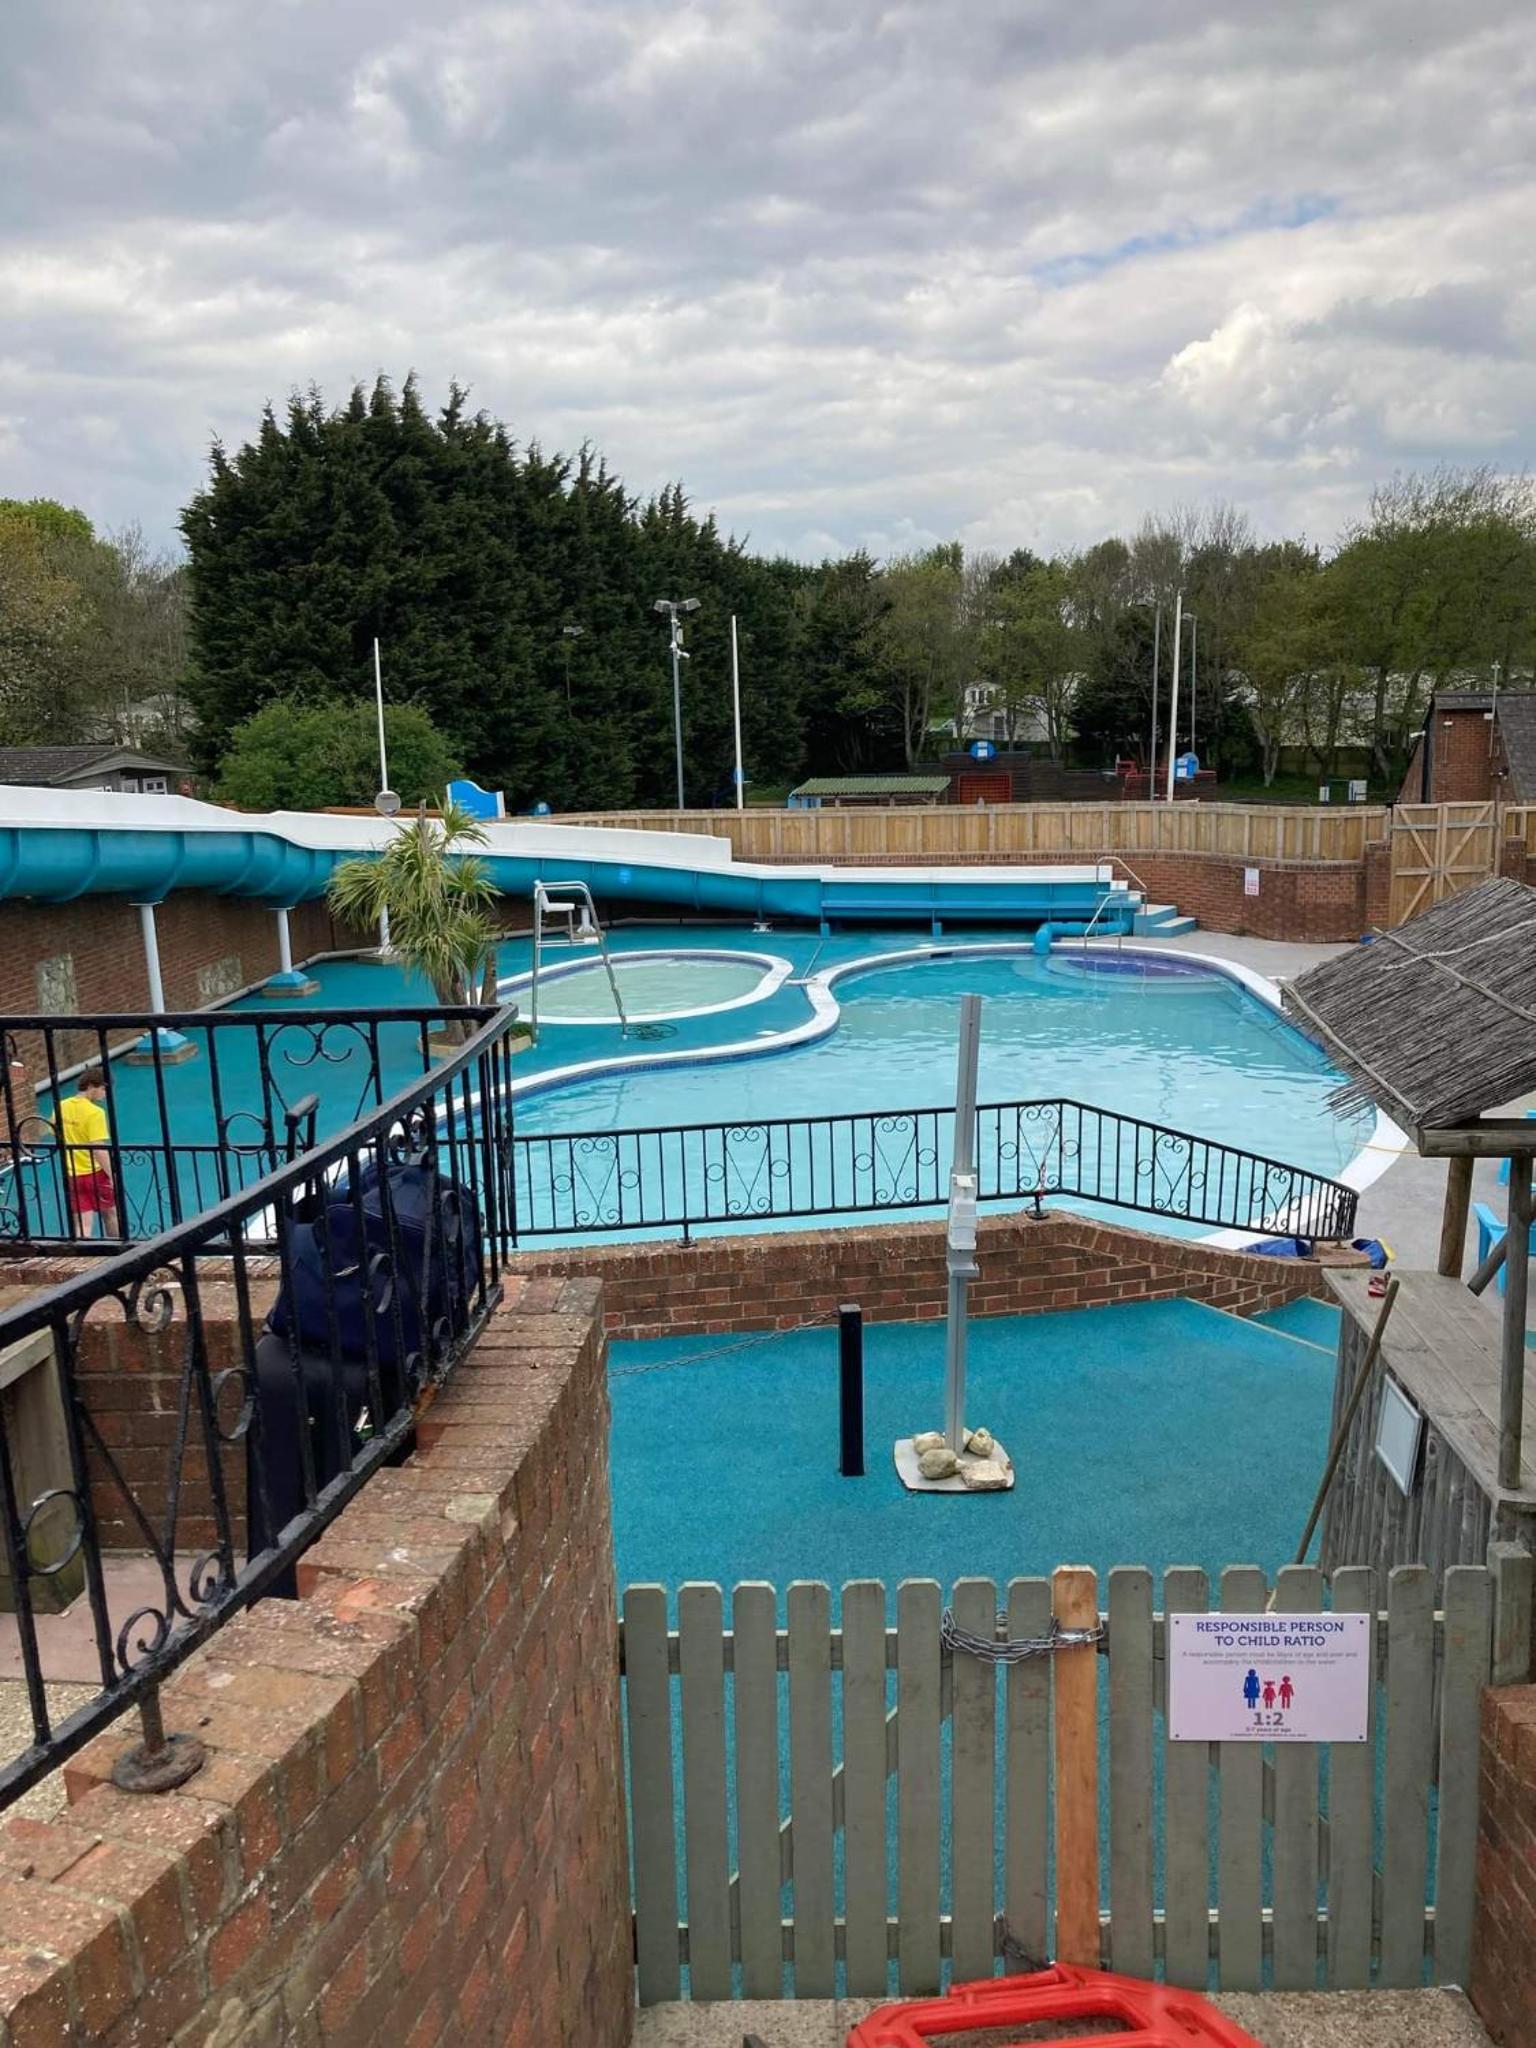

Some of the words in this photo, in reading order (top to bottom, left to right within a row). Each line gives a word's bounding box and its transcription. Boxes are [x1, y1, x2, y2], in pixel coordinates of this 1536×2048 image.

[1196, 1621, 1287, 1632] RESPONSIBLE
[1290, 1621, 1344, 1632] PERSON
[1214, 1635, 1235, 1646] TO
[1237, 1635, 1280, 1646] CHILD
[1284, 1635, 1326, 1646] RATIO
[1253, 1712, 1284, 1726] 1:2
